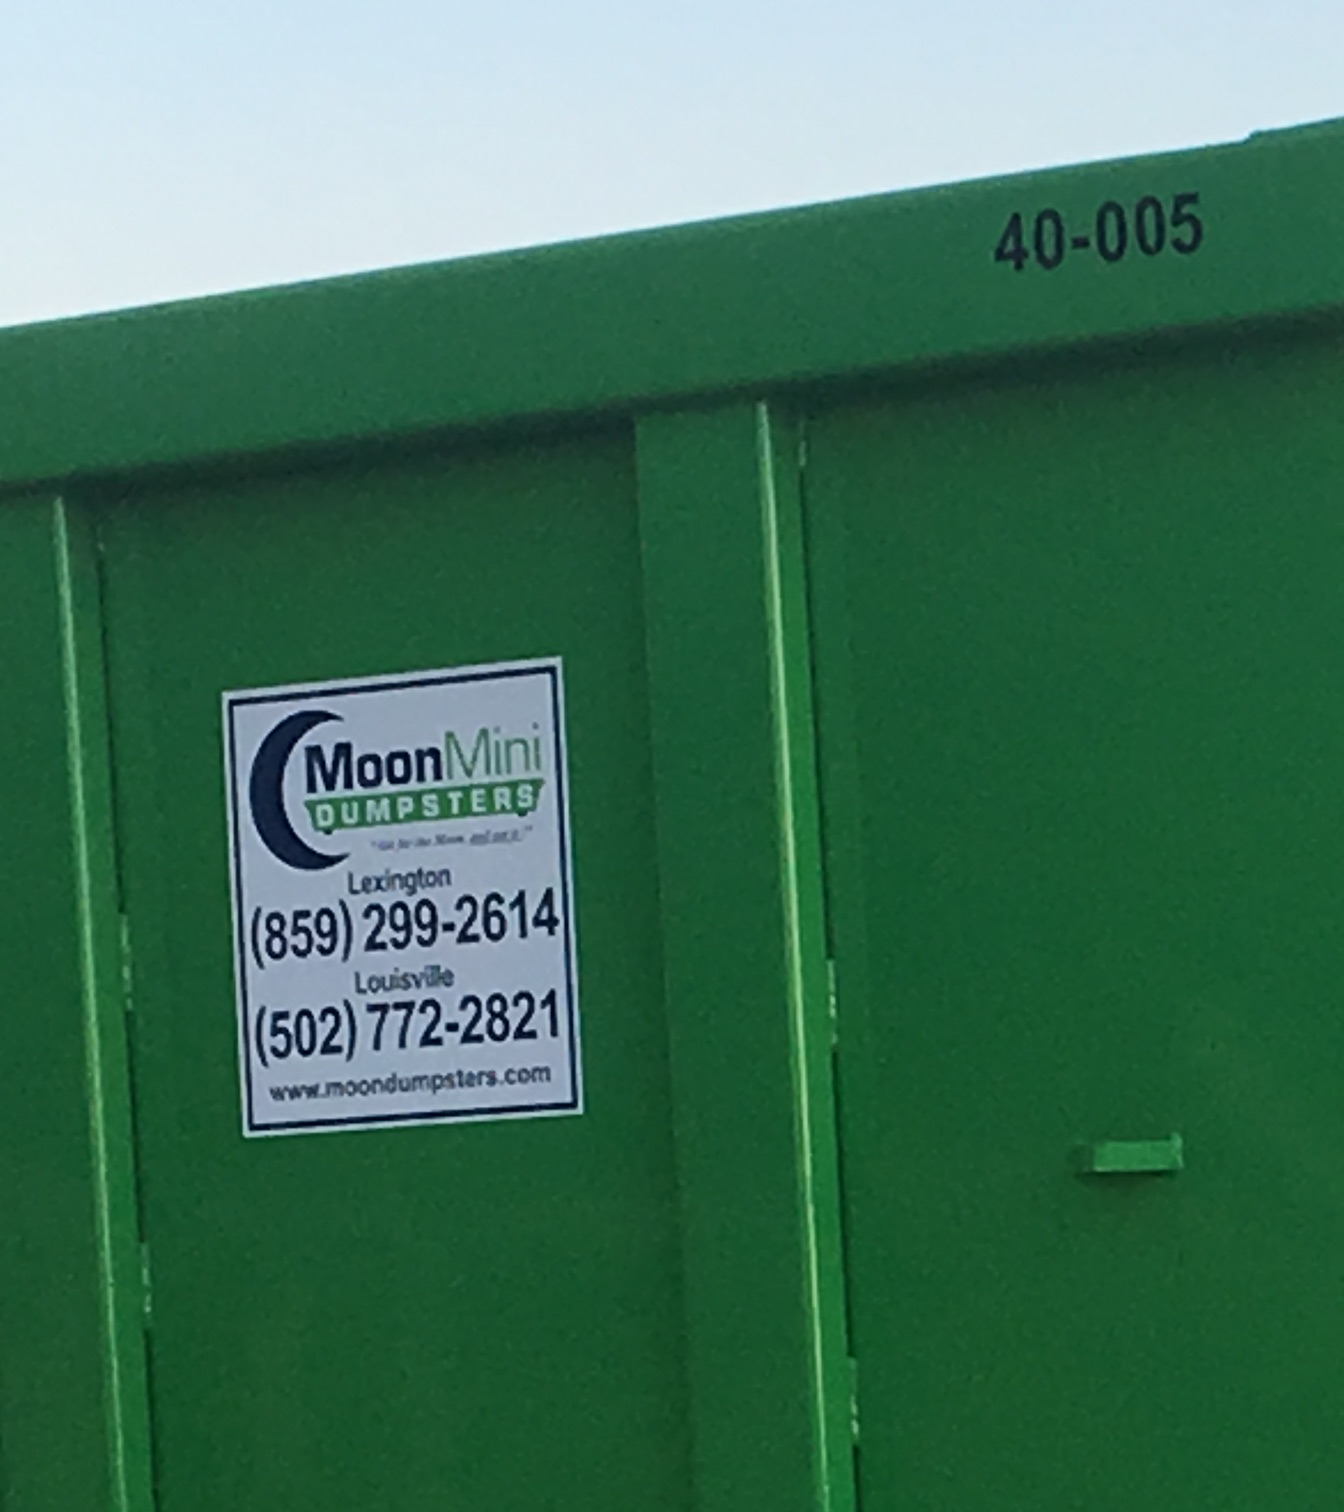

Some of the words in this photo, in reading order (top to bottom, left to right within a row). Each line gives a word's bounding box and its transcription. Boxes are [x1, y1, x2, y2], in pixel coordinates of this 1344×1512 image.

[994, 192, 1203, 271] 40-005
[315, 783, 534, 827] DUMPSTERS
[347, 868, 452, 899] Lexington
[251, 899, 353, 969] (859)
[363, 888, 560, 952] 299-2614
[354, 964, 454, 994] Louisville
[255, 999, 357, 1067] (502)
[366, 990, 560, 1051] 772-2821
[270, 1064, 551, 1101] www.moondumpsters.com
